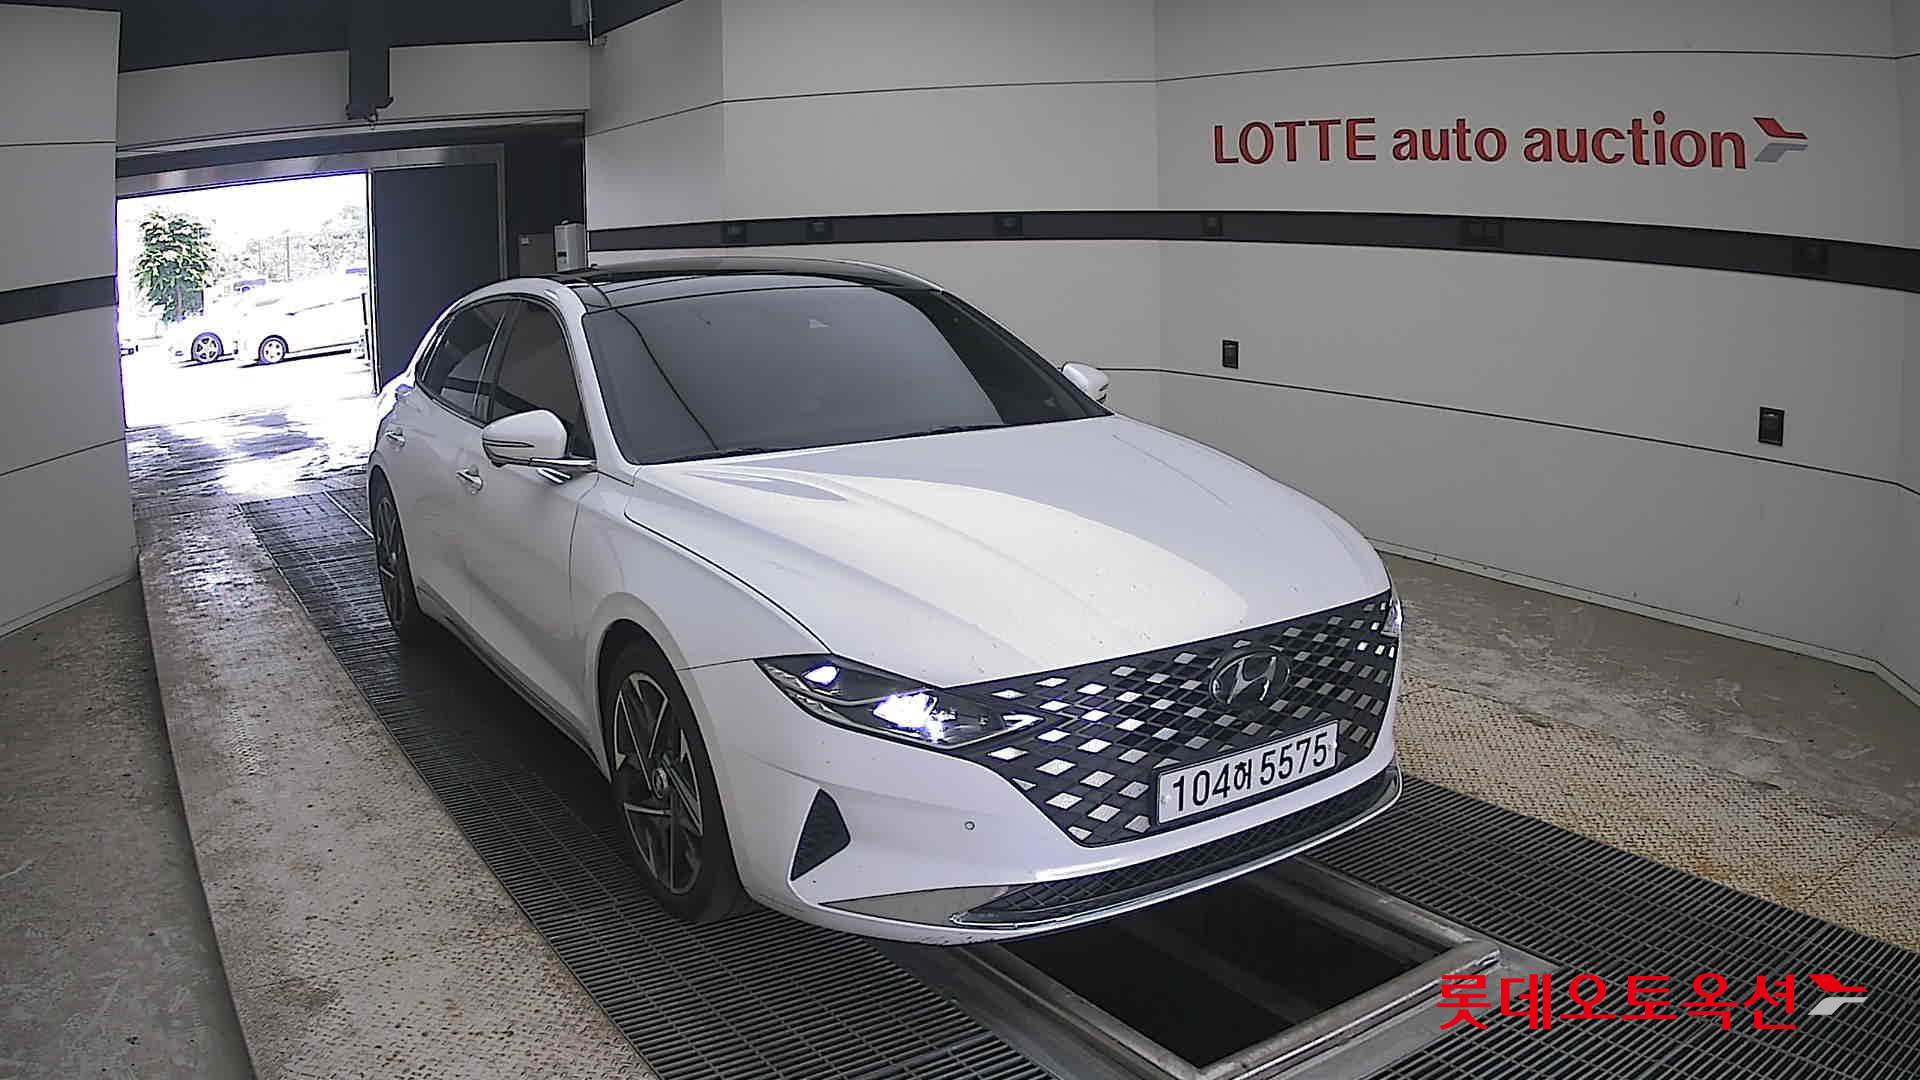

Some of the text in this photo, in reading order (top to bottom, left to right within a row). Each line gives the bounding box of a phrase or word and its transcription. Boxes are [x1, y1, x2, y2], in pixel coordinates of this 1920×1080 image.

[1214, 110, 1748, 170] LOTTE auto auction
